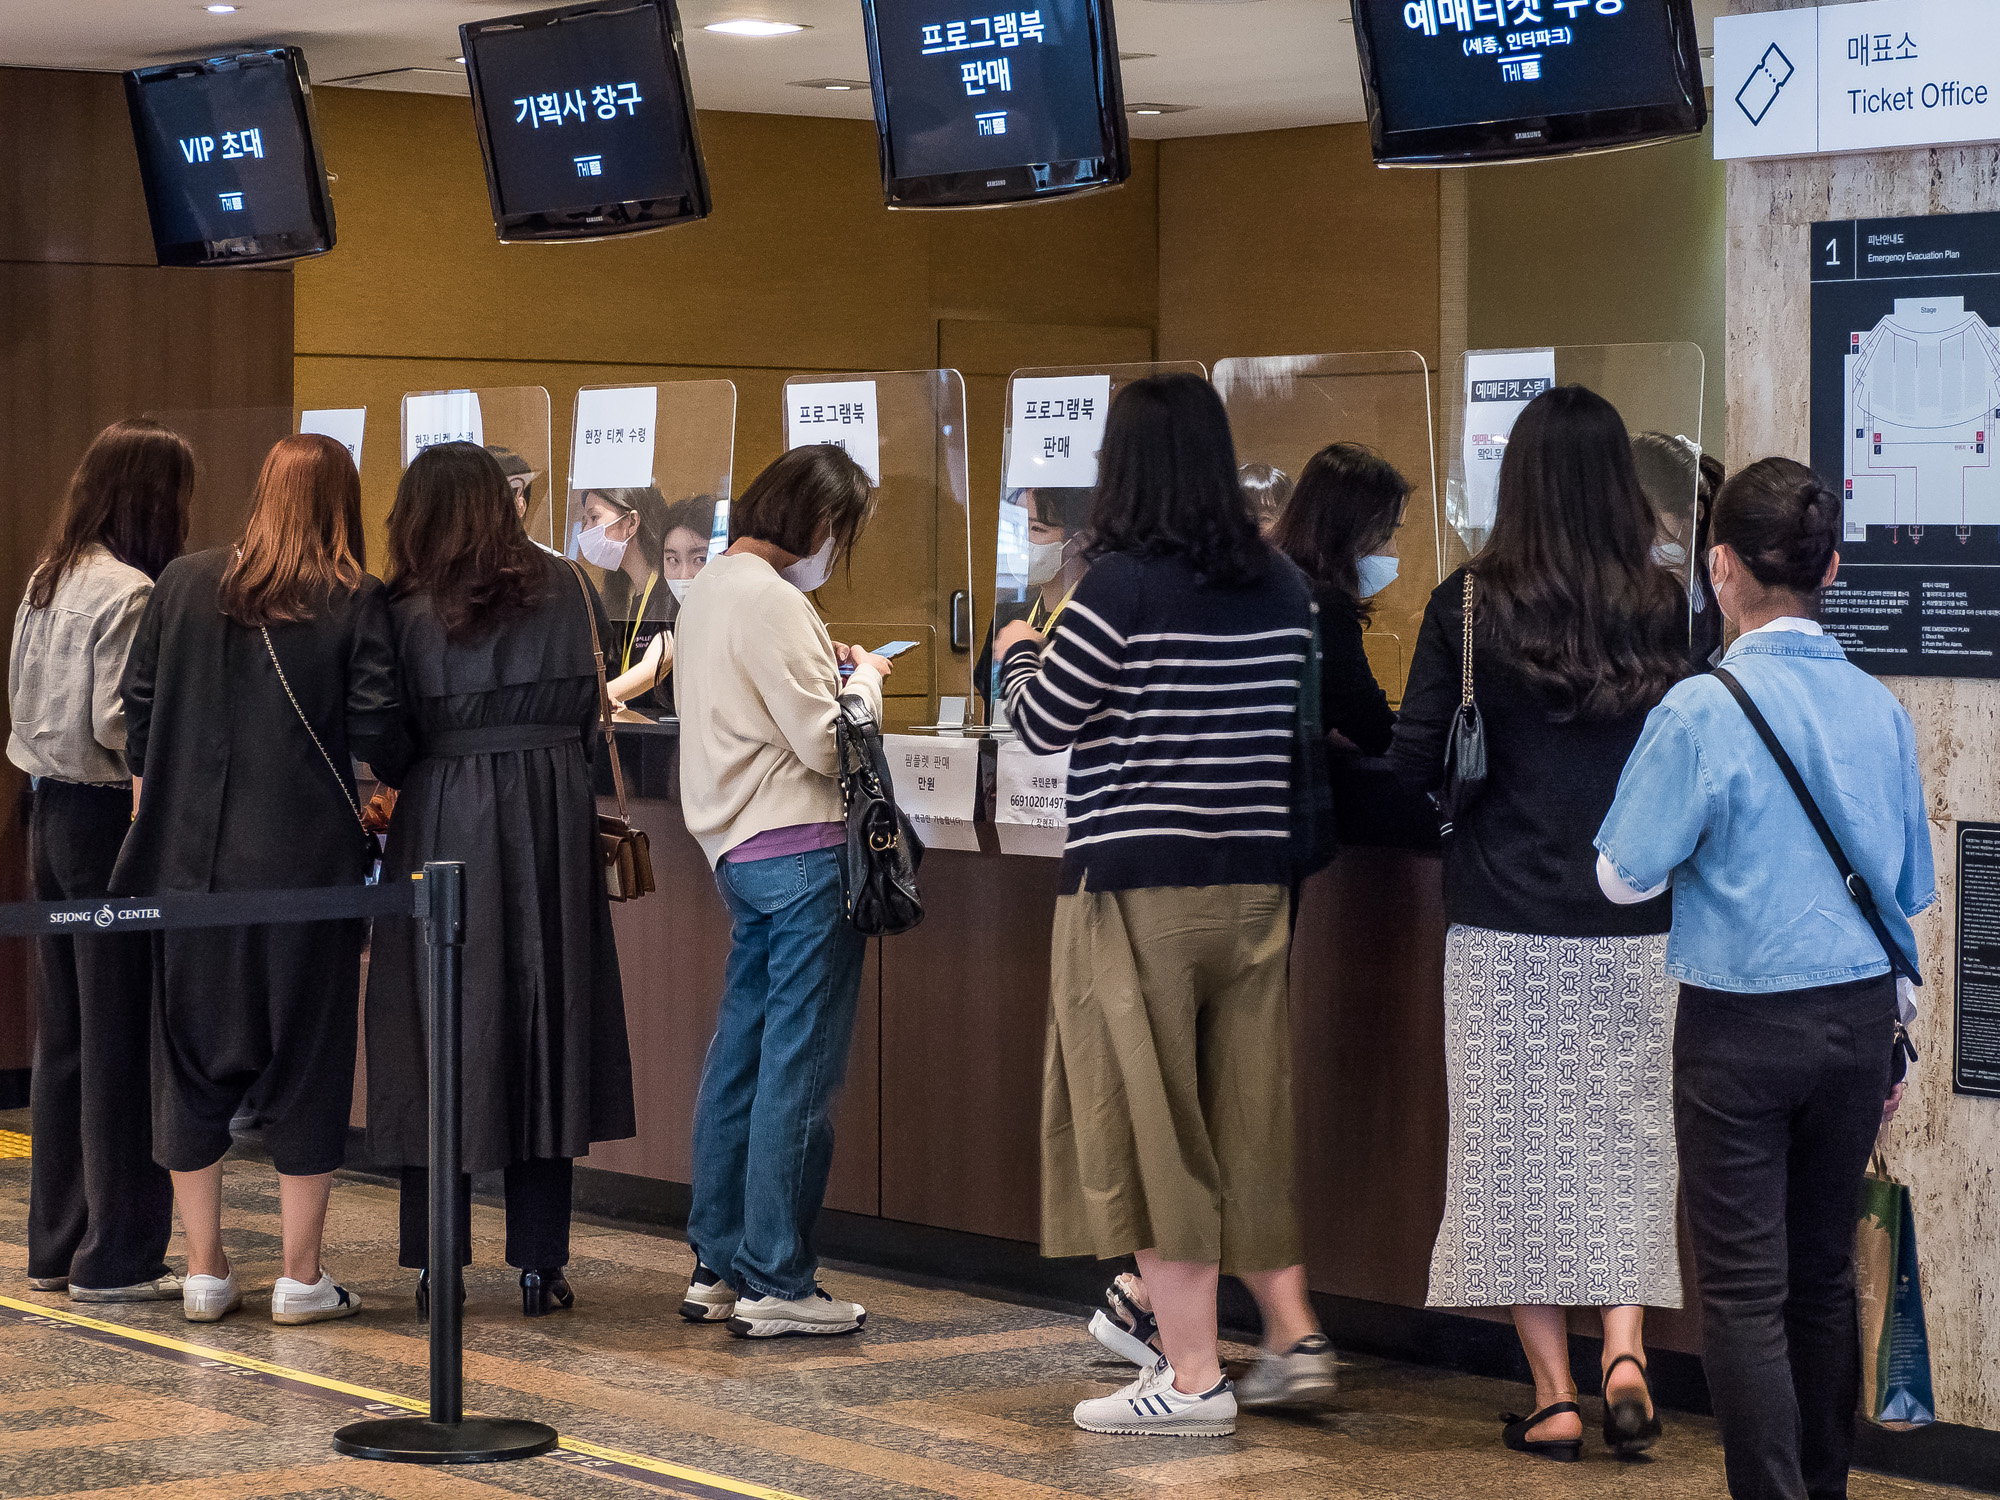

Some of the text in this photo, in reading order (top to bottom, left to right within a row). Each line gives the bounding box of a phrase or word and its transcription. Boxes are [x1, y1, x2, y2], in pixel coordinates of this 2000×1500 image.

[921, 8, 1044, 55] 프로그램북
[1462, 27, 1572, 56] (세종, 인터파크)
[1848, 32, 1918, 67] 매표소
[961, 58, 1012, 95] 판매
[514, 82, 643, 129] 기획사 창구
[1847, 81, 1988, 115] Ticket Office
[180, 128, 263, 164] VIP 초대
[1868, 234, 1905, 246] 피난안내도
[1825, 238, 1841, 266] 1
[1868, 250, 1960, 263] Emergency Evacuation Plan
[1920, 306, 1937, 314] Stage
[1475, 380, 1545, 399] 예매티켓 수령
[799, 402, 865, 424] 프로그램북
[1025, 398, 1095, 421] 프로그램북
[585, 428, 646, 444] 현장 티켓 수령
[1043, 436, 1071, 459] 판매
[1477, 448, 1502, 459] 확인 후
[905, 754, 950, 770] 팜플렛 판매
[918, 777, 935, 791] 만원
[1032, 777, 1058, 789] 국민은행
[50, 909, 161, 925] SEJONG CENTER
